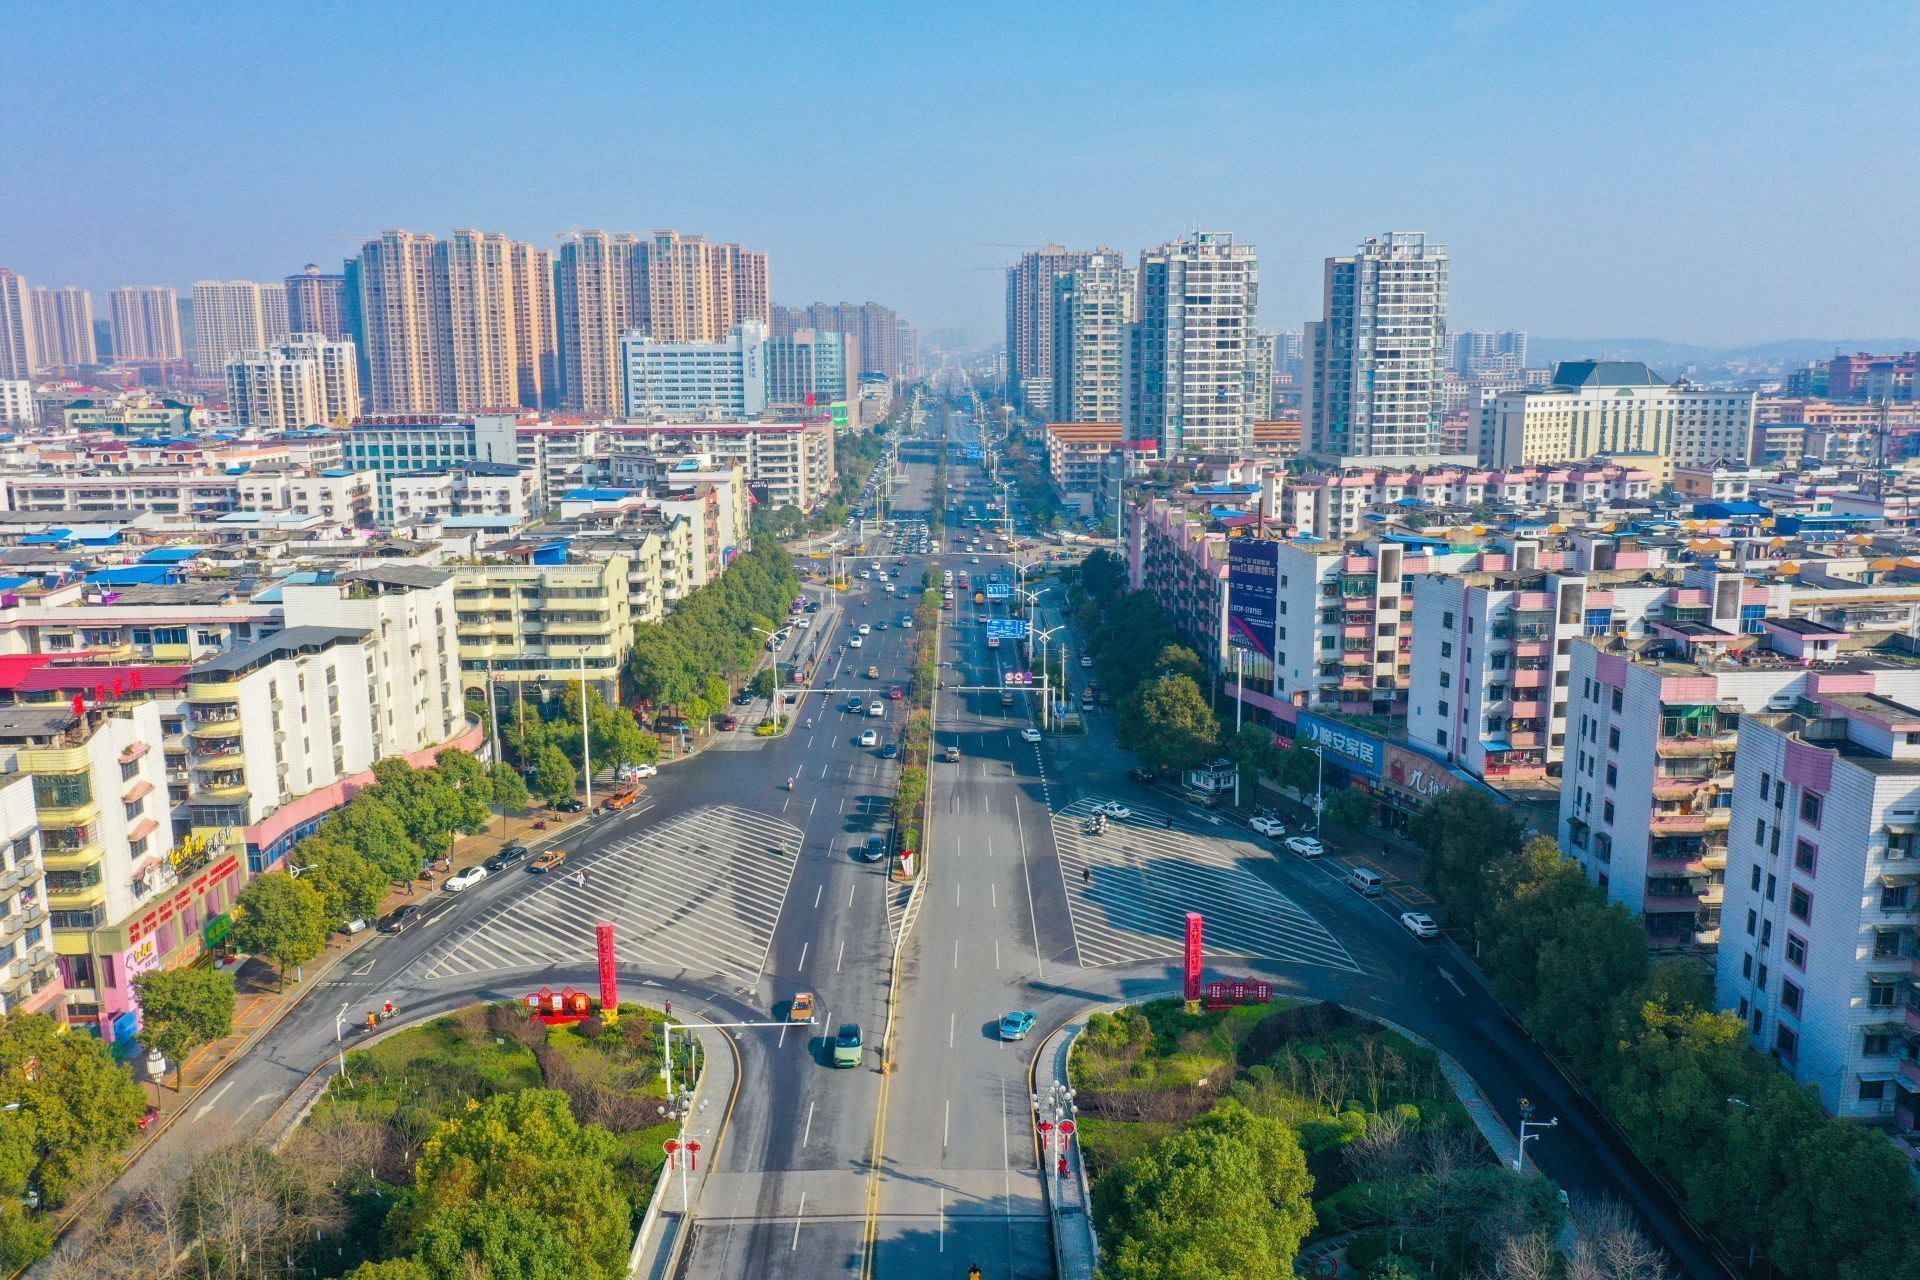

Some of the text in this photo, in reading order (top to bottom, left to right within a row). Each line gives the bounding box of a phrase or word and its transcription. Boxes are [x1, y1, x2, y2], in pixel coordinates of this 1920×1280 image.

[352, 415, 441, 425] 中国农业发展银行
[1318, 726, 1374, 764] 晚安家居
